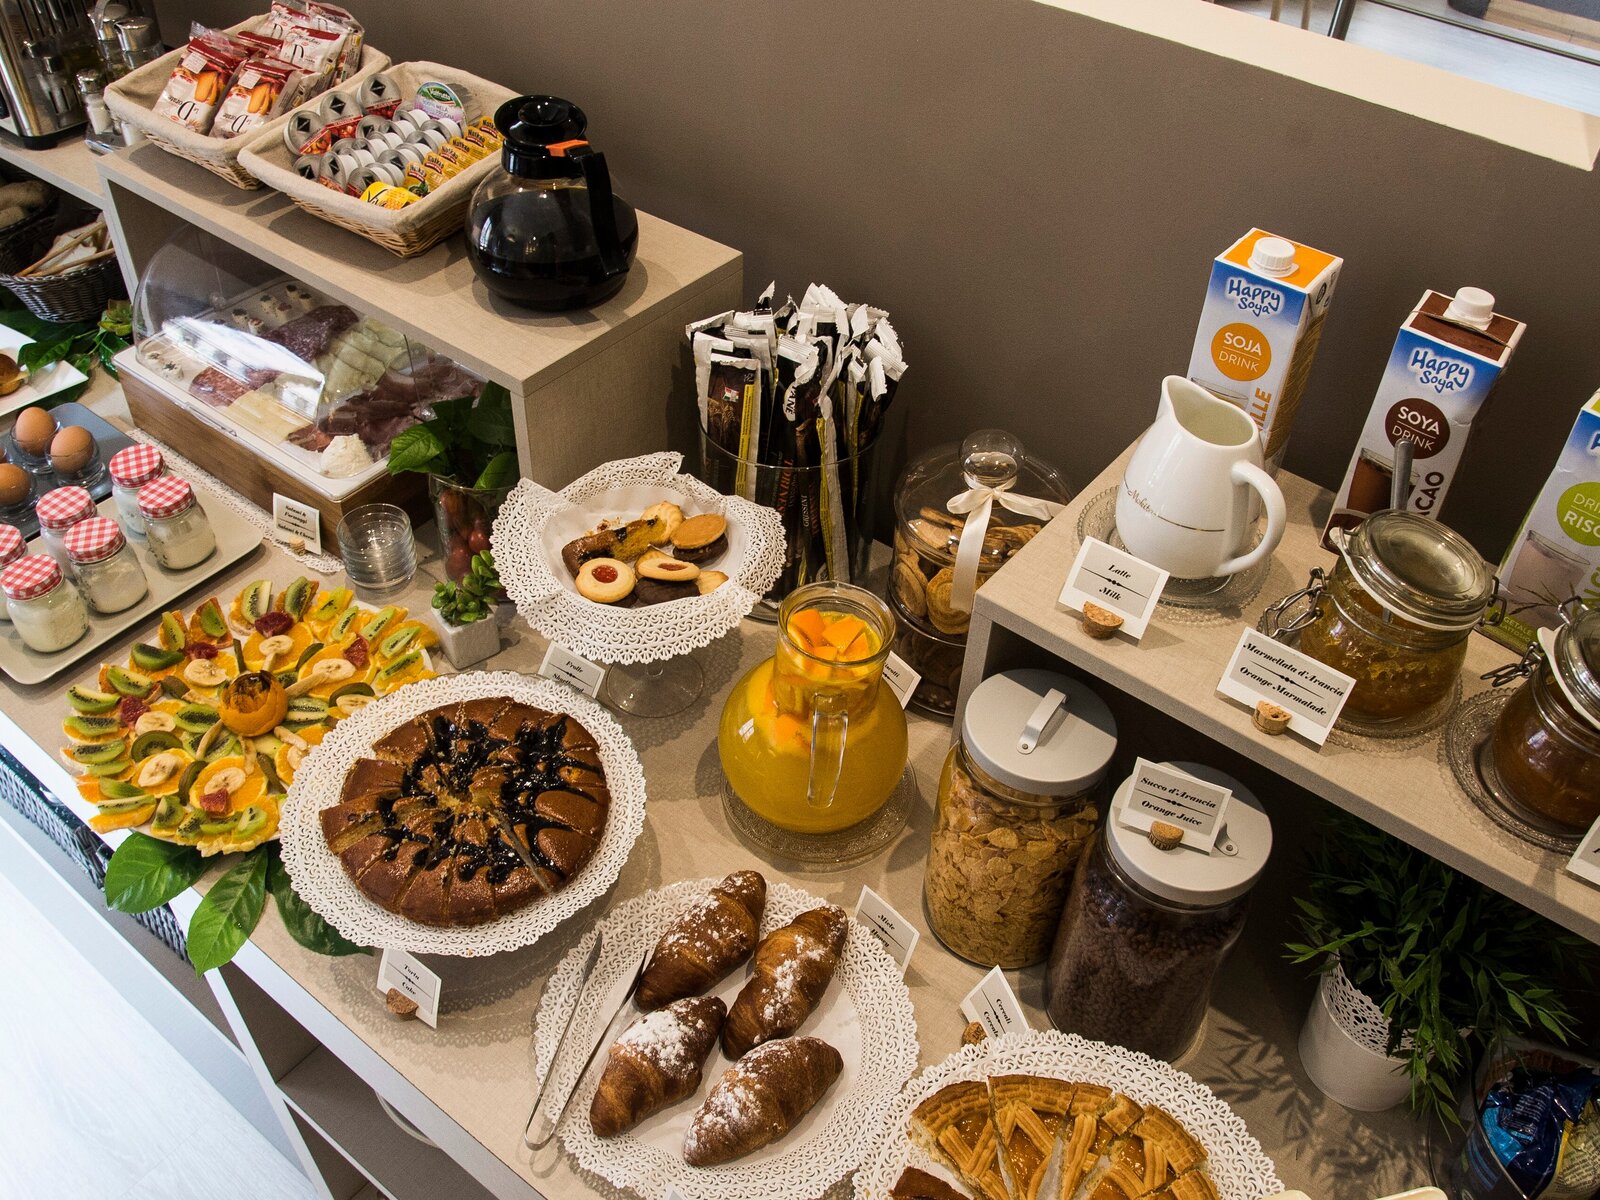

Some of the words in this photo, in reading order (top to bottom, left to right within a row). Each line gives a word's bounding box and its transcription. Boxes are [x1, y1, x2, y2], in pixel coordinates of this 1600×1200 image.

[1228, 279, 1281, 312] Happy
[1237, 296, 1270, 318] Soya
[1223, 332, 1262, 356] SOJA
[1218, 350, 1259, 372] DRINK
[1411, 349, 1470, 388] Happy
[1419, 370, 1455, 394] Soya
[1397, 406, 1440, 436] SOYA
[1392, 424, 1436, 452] DRINK
[1108, 564, 1132, 579] Latte
[1098, 587, 1122, 601] Milk
[1242, 642, 1298, 673] Marmellata
[1297, 670, 1345, 697] d'Arancia
[1239, 666, 1273, 688] Orange
[1272, 683, 1327, 716] Marmalade
[1140, 776, 1168, 791] Succo
[1168, 786, 1217, 809] d'Arancia
[1141, 800, 1176, 817] Orange
[1176, 813, 1203, 826] Juice
[877, 913, 896, 931] Miele
[995, 998, 1012, 1024] Cereali
